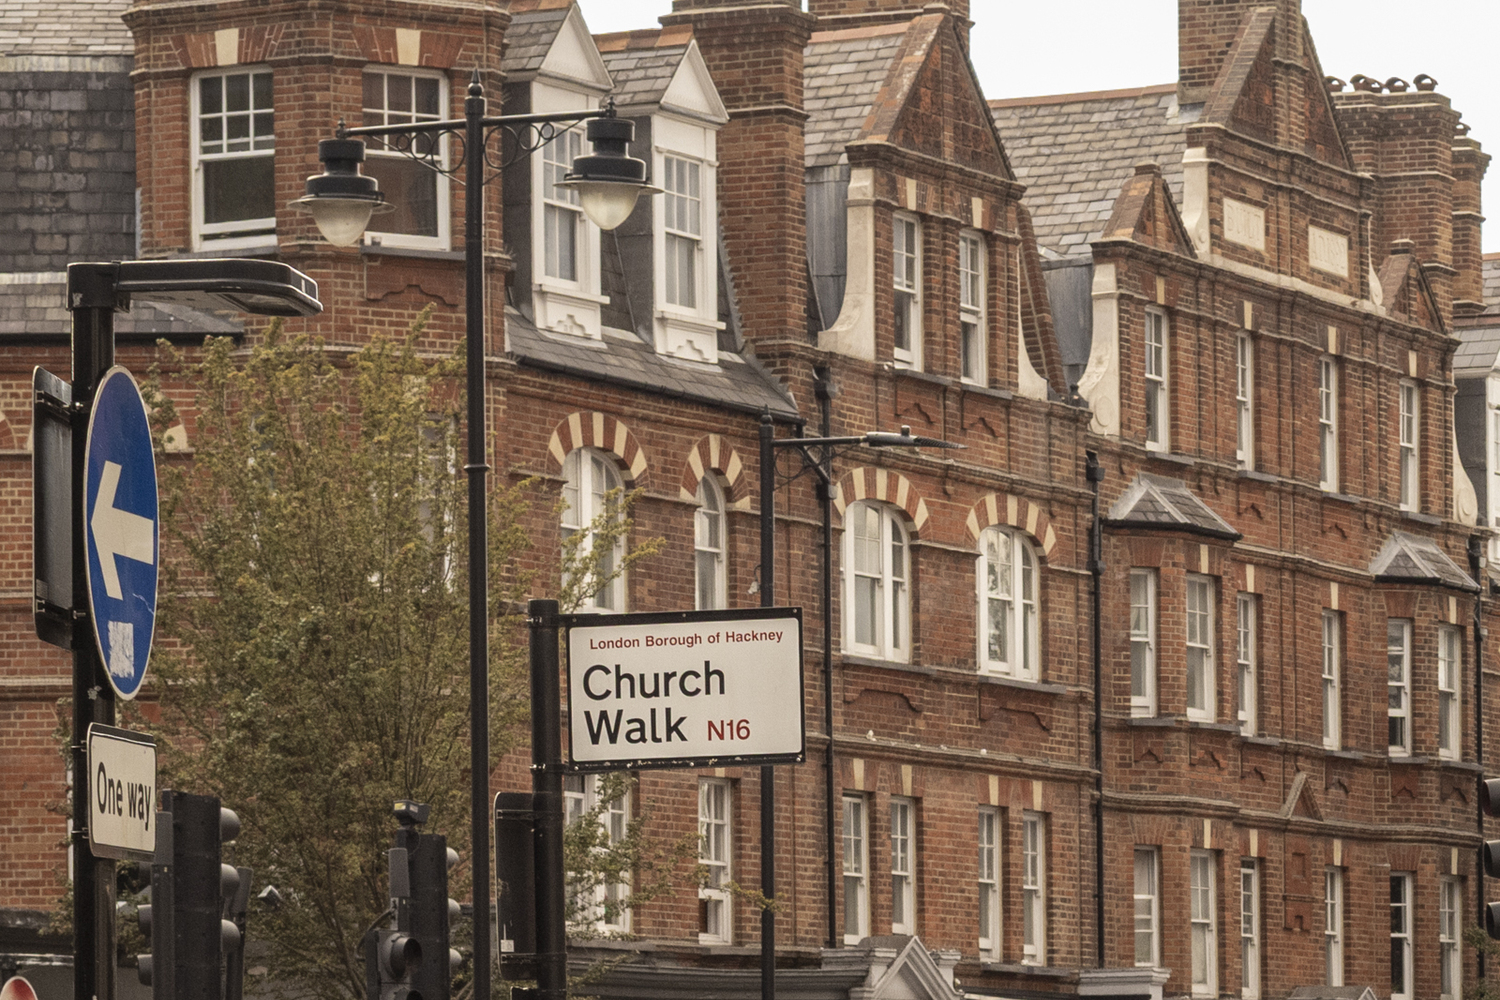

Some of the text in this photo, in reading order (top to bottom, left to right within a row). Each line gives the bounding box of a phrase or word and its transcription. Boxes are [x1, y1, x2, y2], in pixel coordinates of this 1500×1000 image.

[589, 630, 784, 650] London Borough of Hackney
[583, 660, 725, 701] Church
[584, 707, 751, 745] Walk N16
[97, 761, 152, 831] One way
